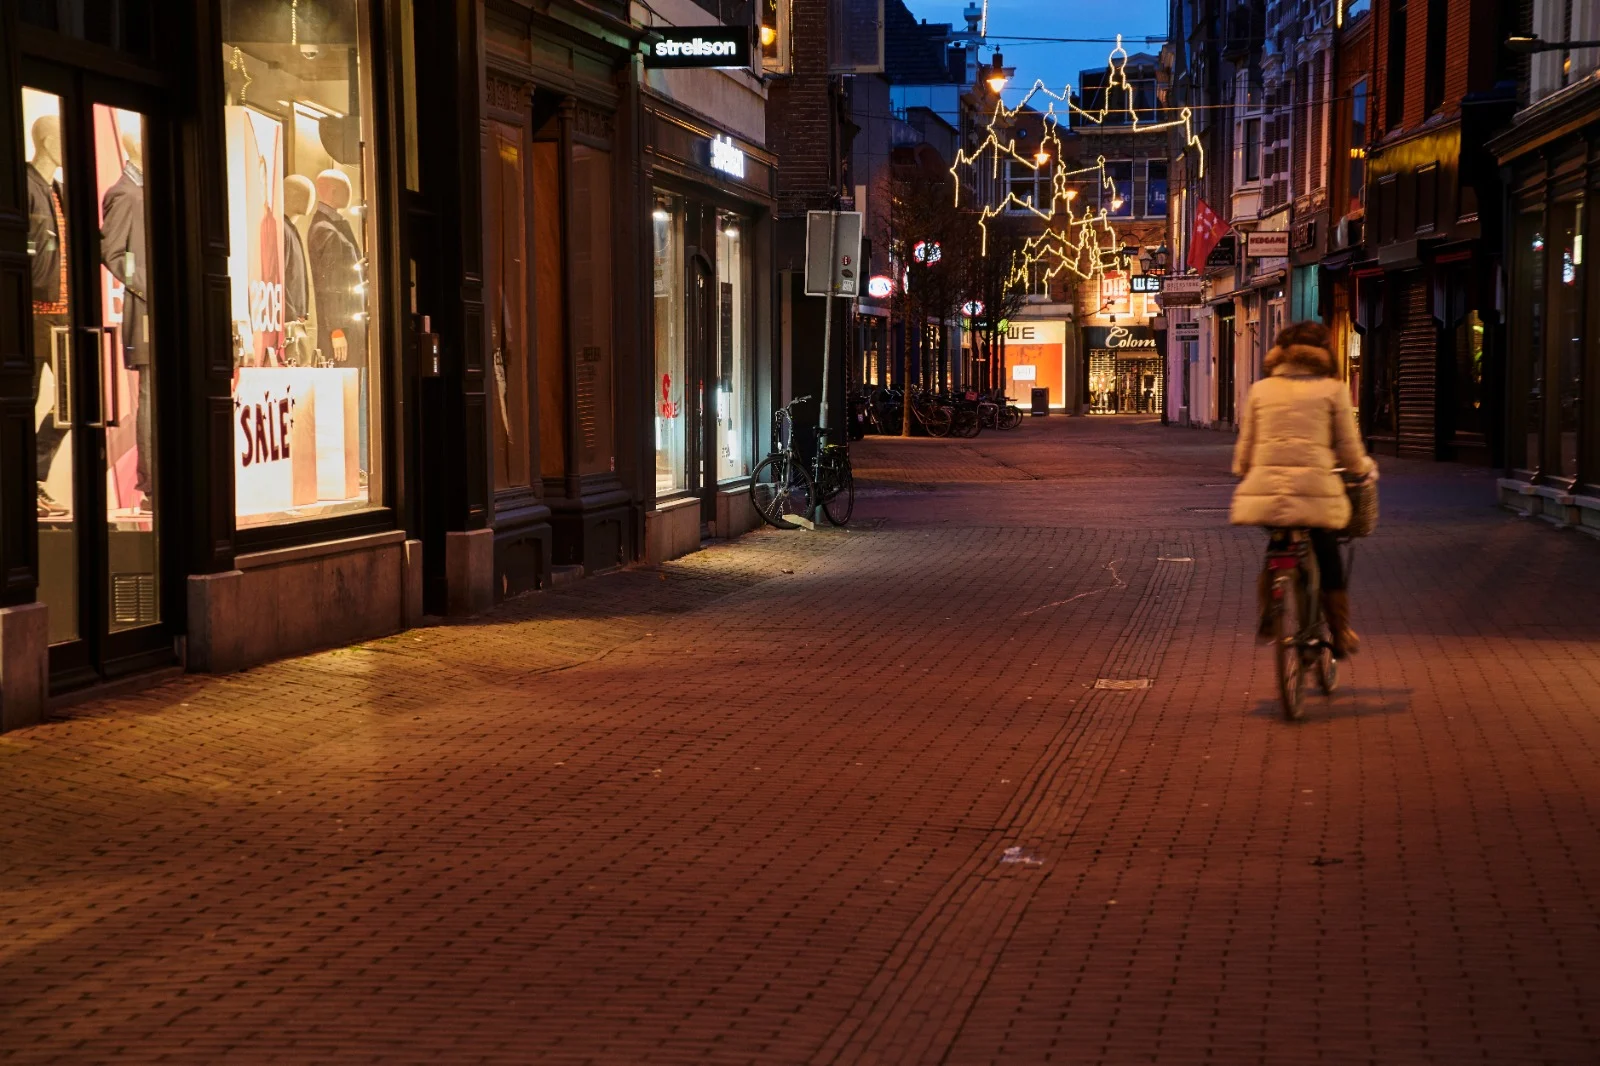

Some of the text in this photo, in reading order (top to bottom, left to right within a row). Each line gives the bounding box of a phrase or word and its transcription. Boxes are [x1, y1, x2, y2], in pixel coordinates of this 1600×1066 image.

[656, 38, 736, 56] strellson
[1133, 278, 1160, 290] WE
[1007, 326, 1035, 340] WE
[240, 398, 290, 467] SALE
